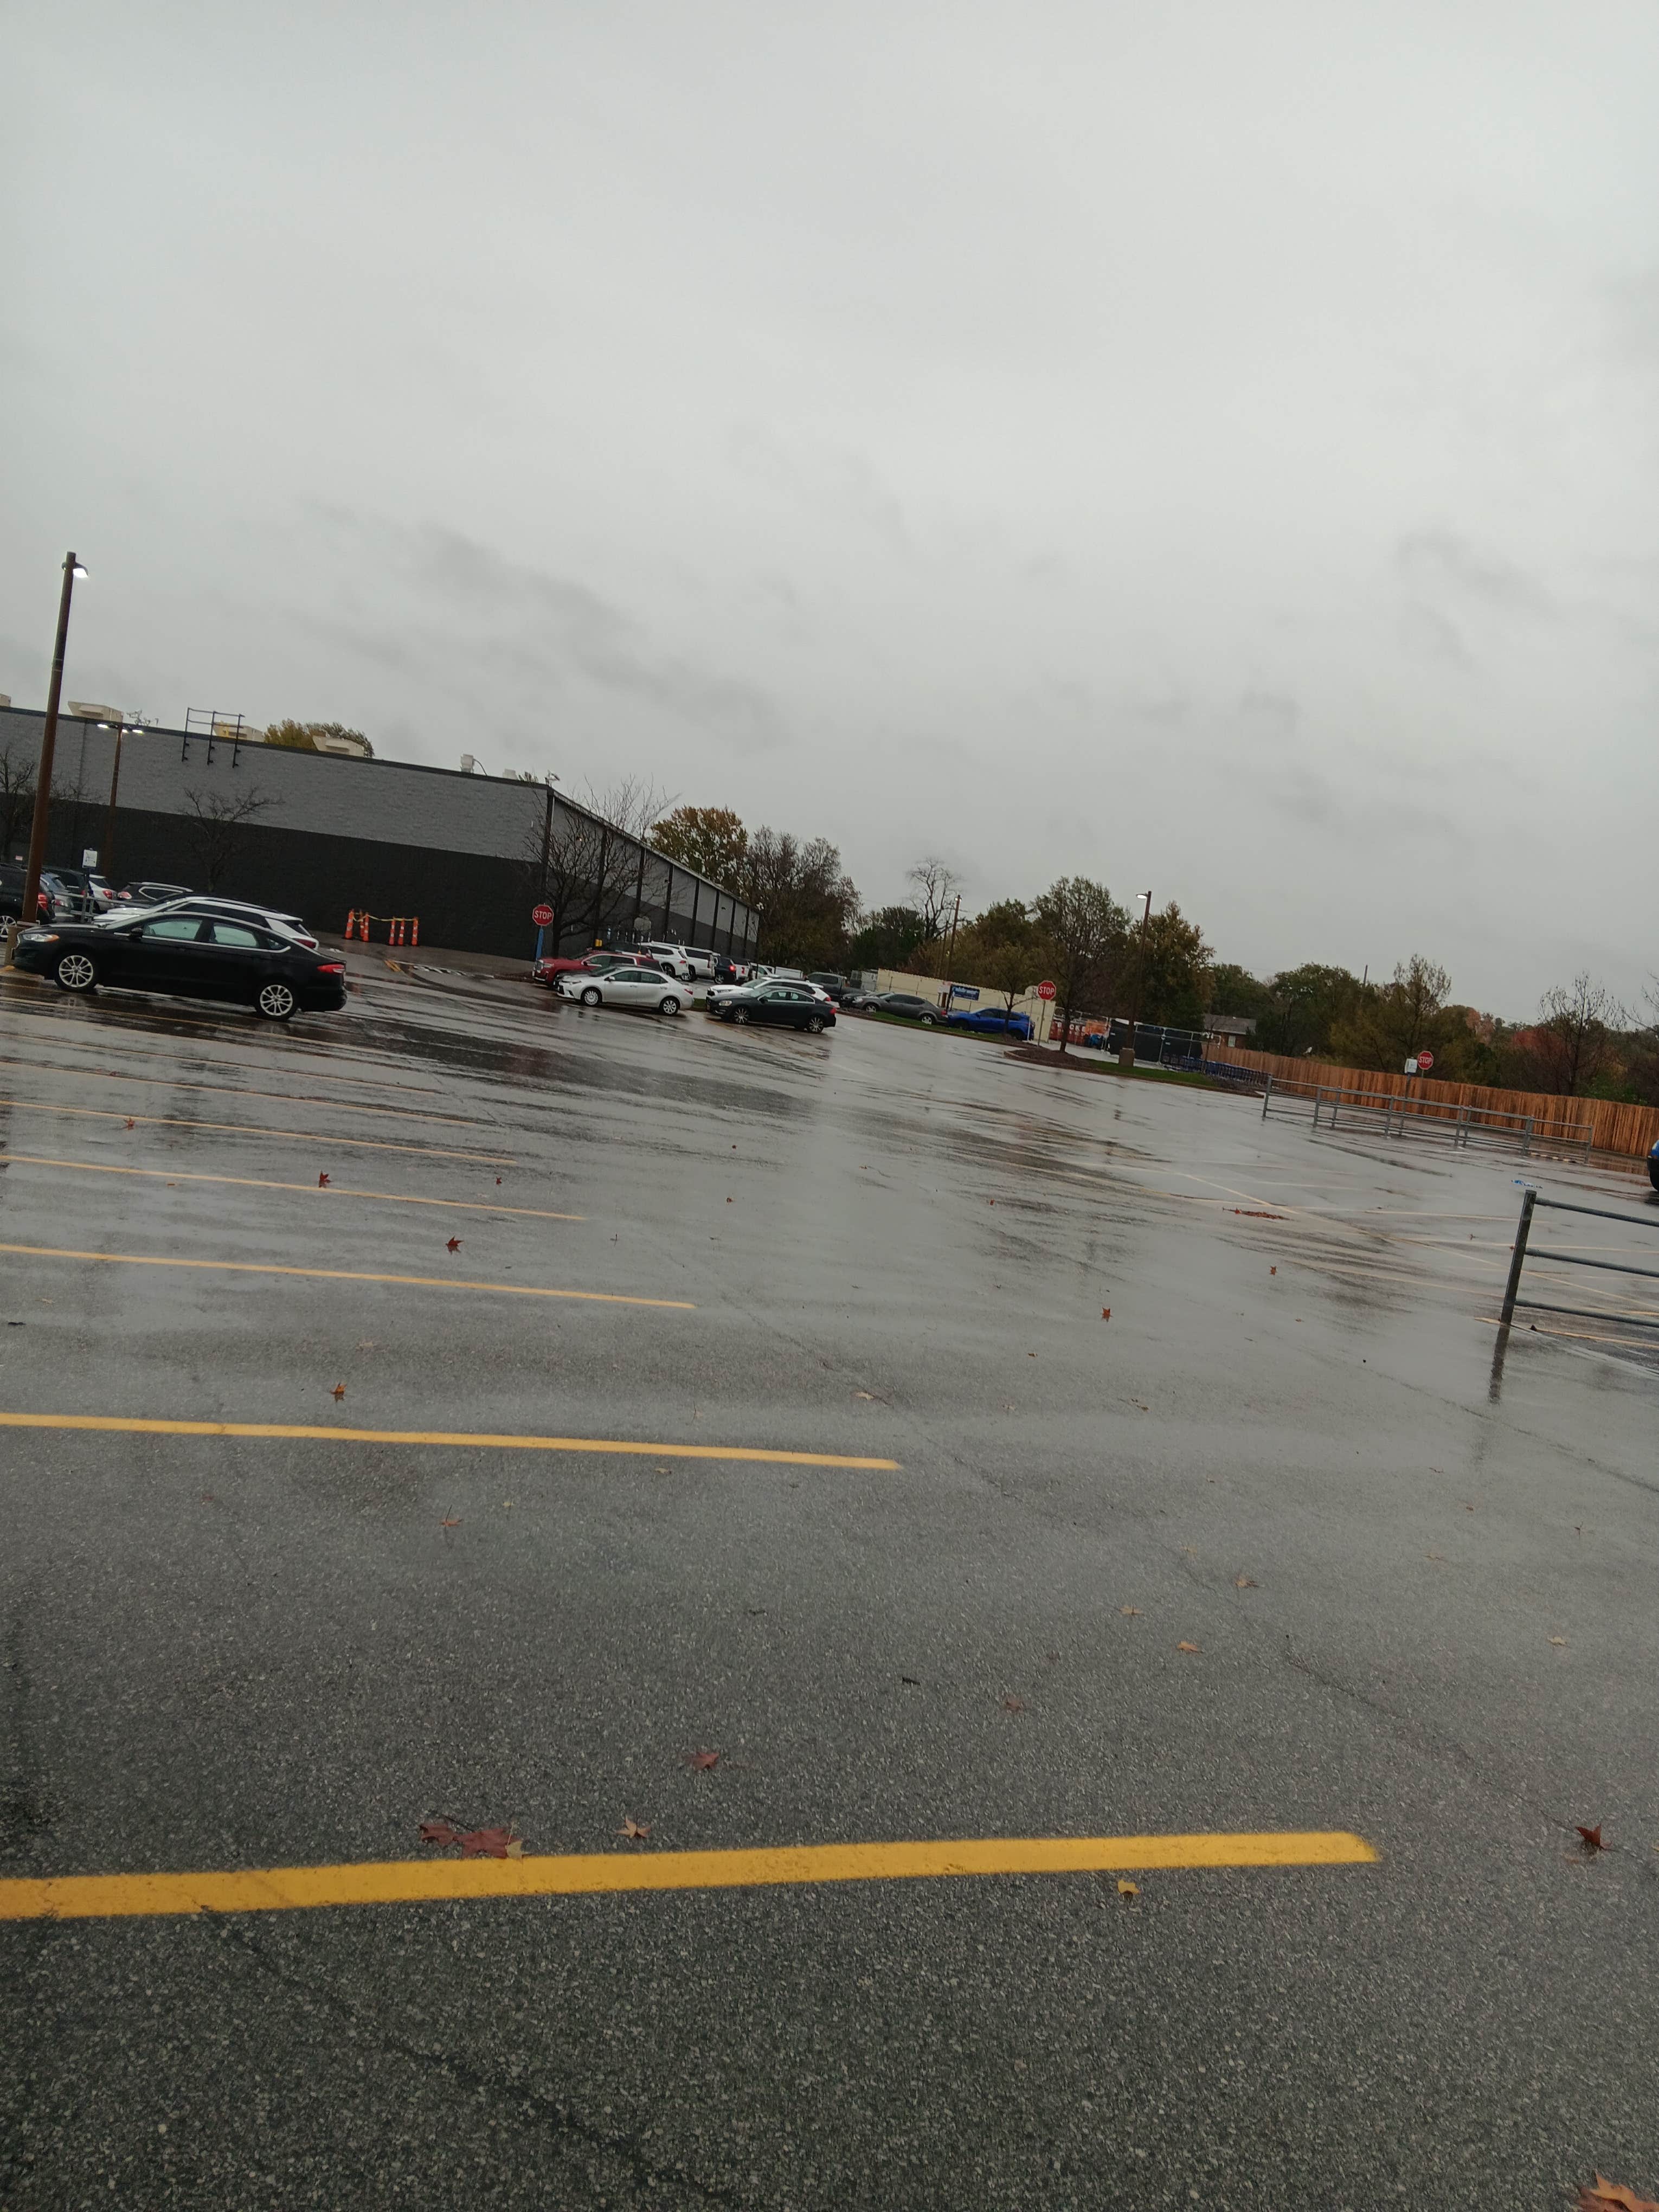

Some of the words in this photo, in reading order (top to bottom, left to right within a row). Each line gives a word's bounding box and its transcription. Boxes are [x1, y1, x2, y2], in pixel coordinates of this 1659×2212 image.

[534, 910, 552, 919] STOP
[1039, 986, 1055, 995] STOP
[1418, 1056, 1432, 1064] STOP
